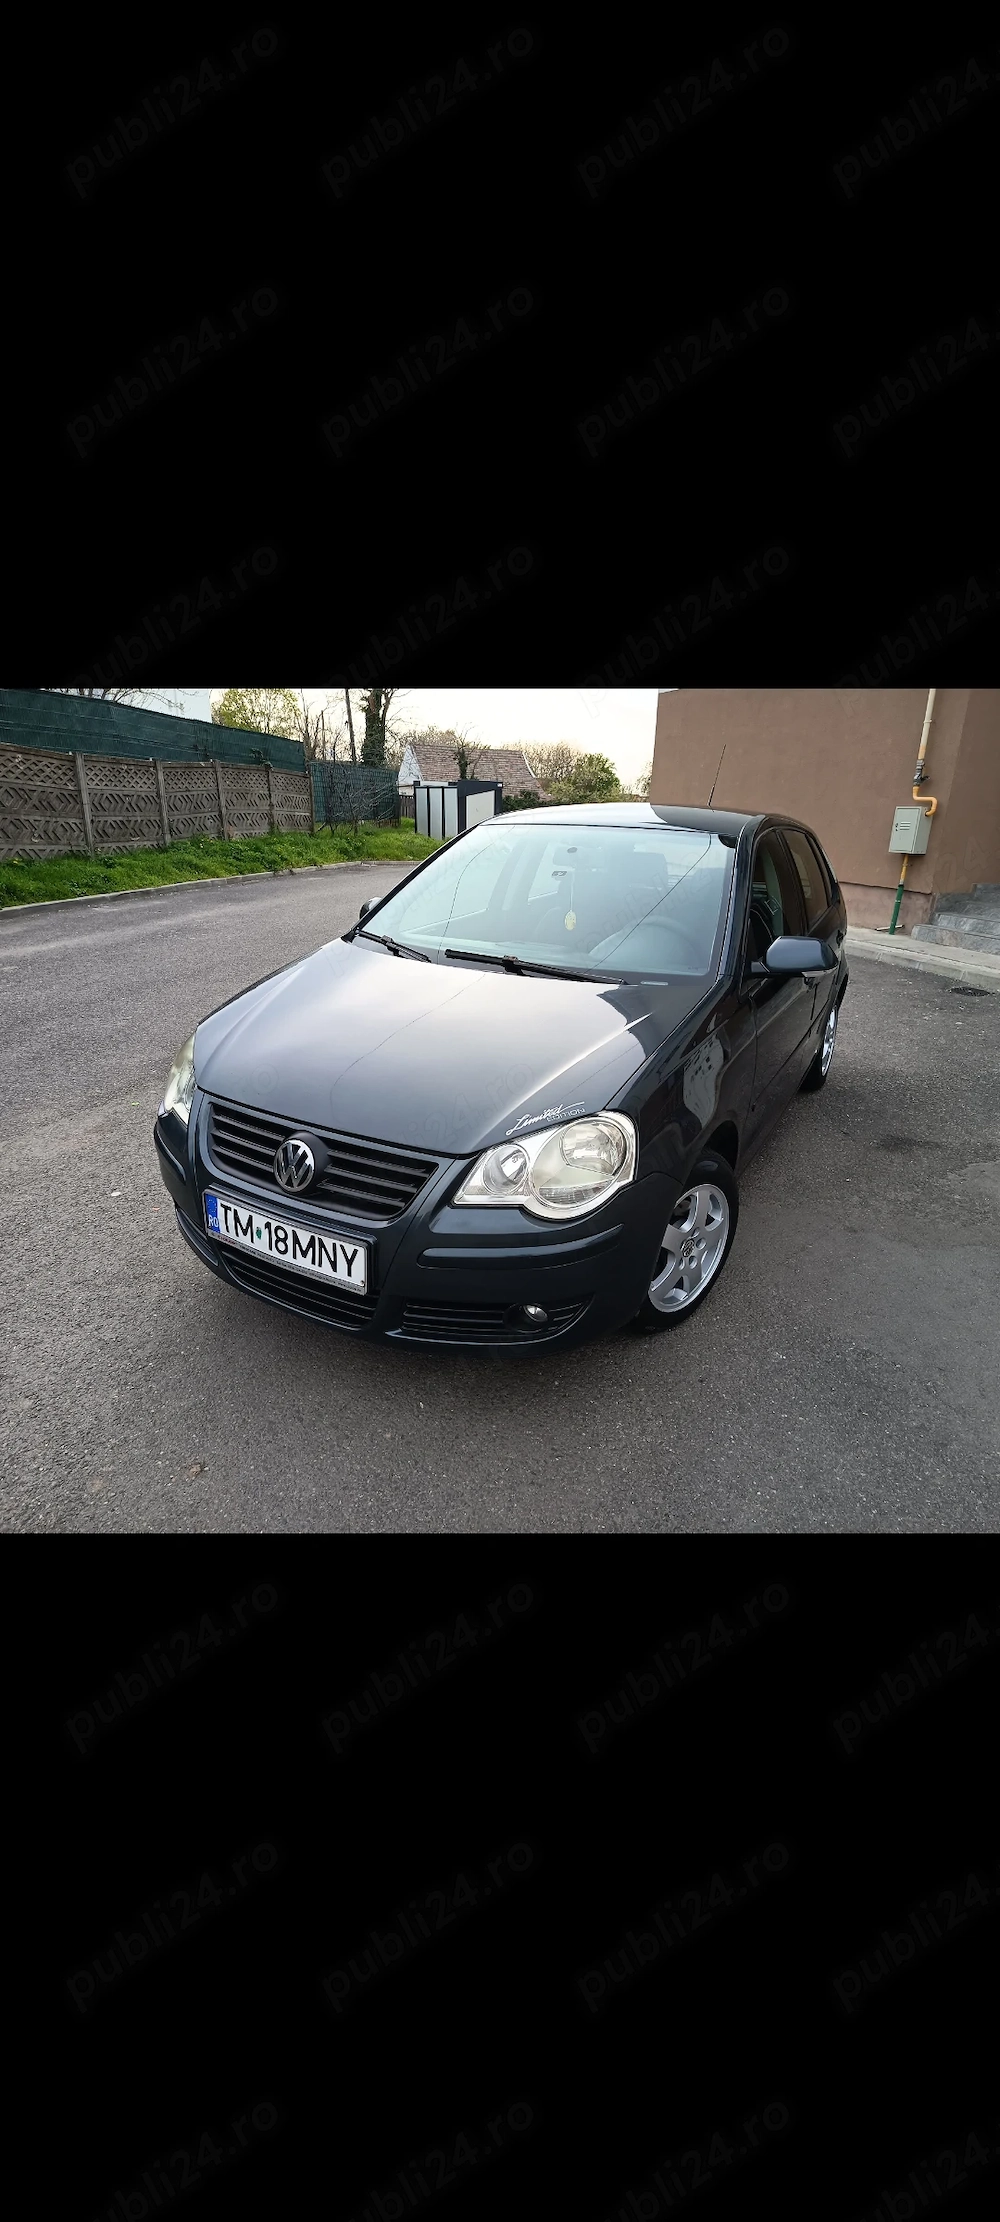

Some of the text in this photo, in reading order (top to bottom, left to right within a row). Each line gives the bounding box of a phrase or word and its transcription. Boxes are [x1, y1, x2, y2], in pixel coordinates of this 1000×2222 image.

[506, 1101, 584, 1135] Limited
[547, 1108, 585, 1122] EDITION
[208, 1214, 219, 1227] RO
